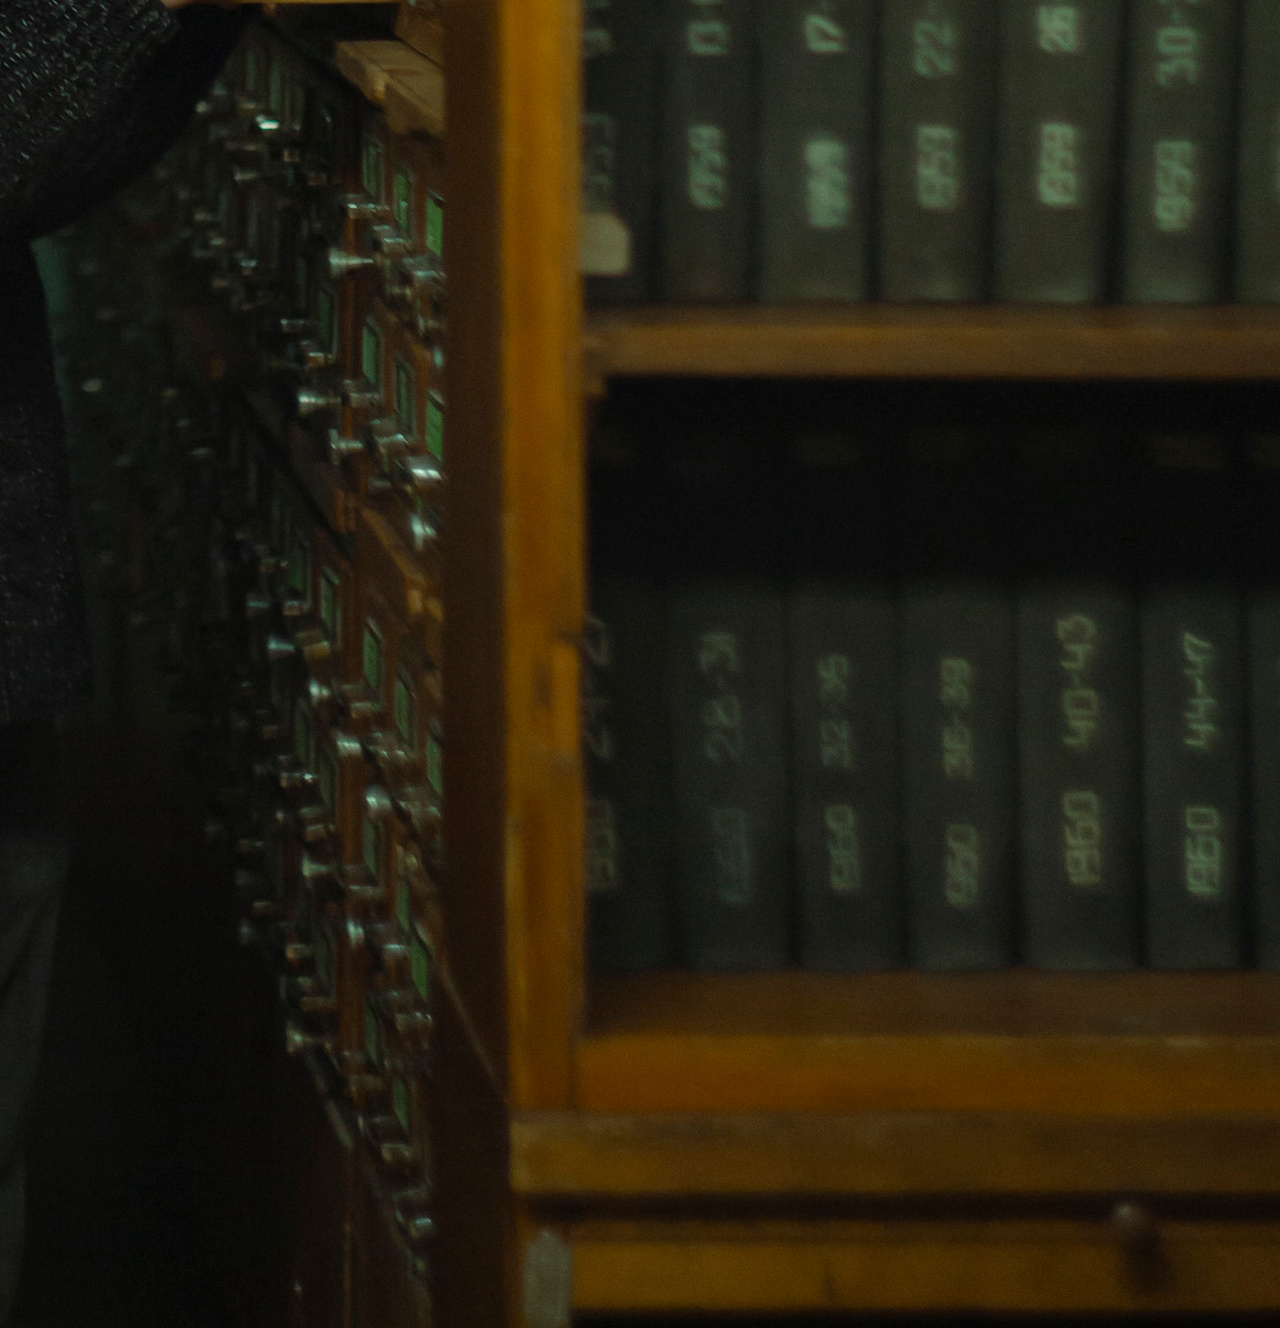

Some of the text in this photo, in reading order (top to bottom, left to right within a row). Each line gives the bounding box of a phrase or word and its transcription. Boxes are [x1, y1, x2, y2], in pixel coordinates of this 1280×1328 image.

[1055, 615, 1100, 885] 1960 40-43
[1183, 631, 1219, 896] 1960 44-47
